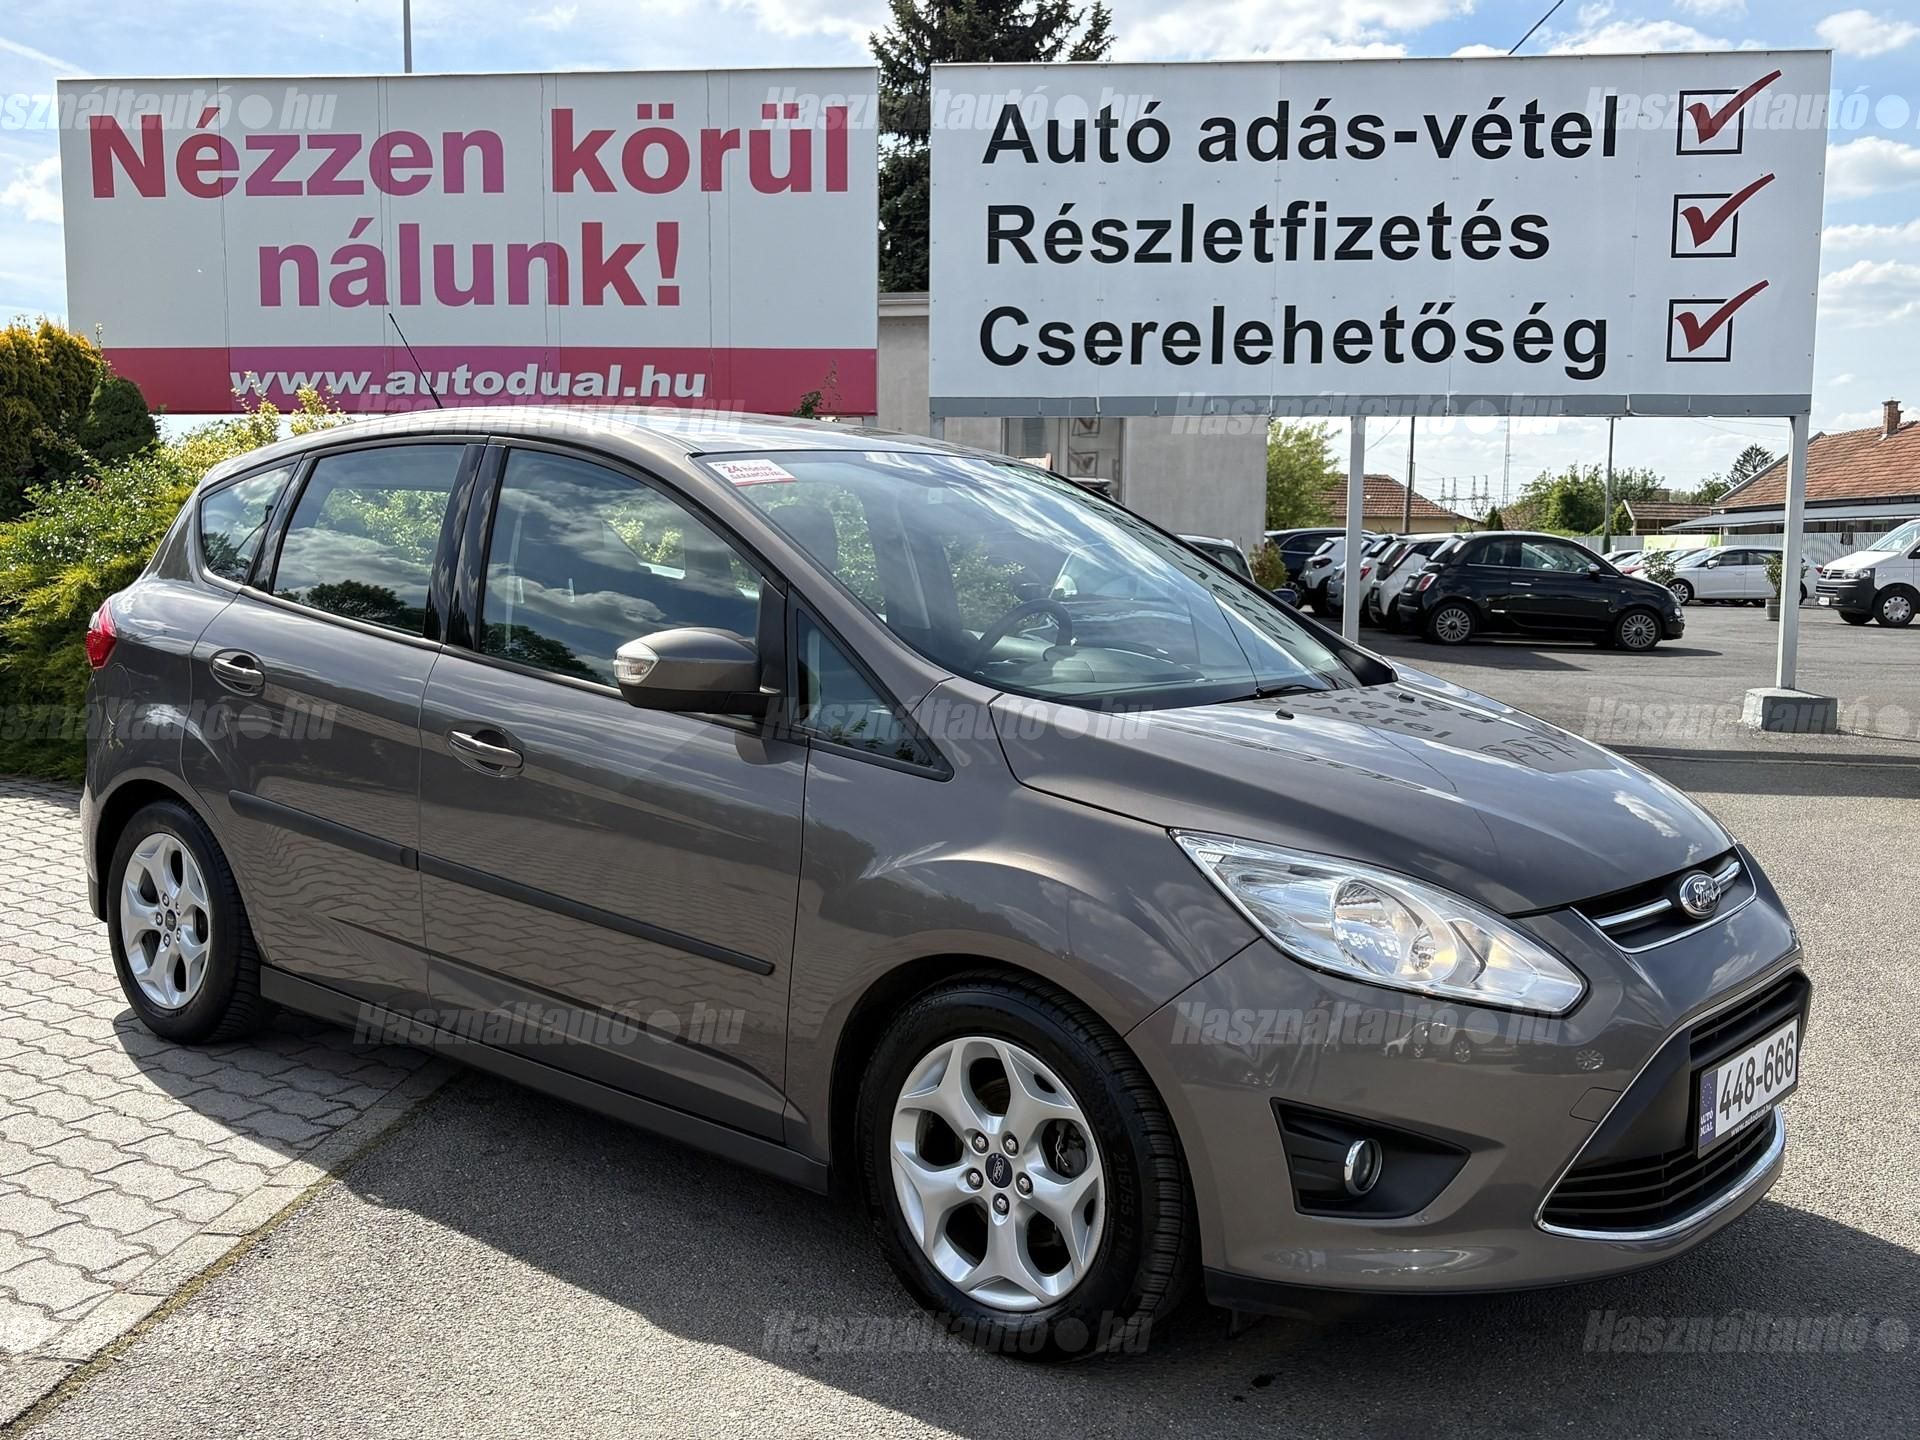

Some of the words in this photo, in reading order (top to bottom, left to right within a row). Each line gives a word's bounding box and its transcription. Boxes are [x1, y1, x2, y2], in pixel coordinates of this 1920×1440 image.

[90, 107, 504, 198] Nézzen
[552, 103, 849, 193] körül
[982, 102, 1171, 164] Autó
[1198, 95, 1618, 162] adás-vétel
[258, 217, 681, 308] nálunk!
[986, 199, 1550, 264] Részletfizetés
[980, 302, 1608, 380] Cserelehetőség
[230, 363, 706, 398] www.autodual.hu
[1693, 880, 1720, 907] Ford
[1718, 1030, 1795, 1121] 448-666
